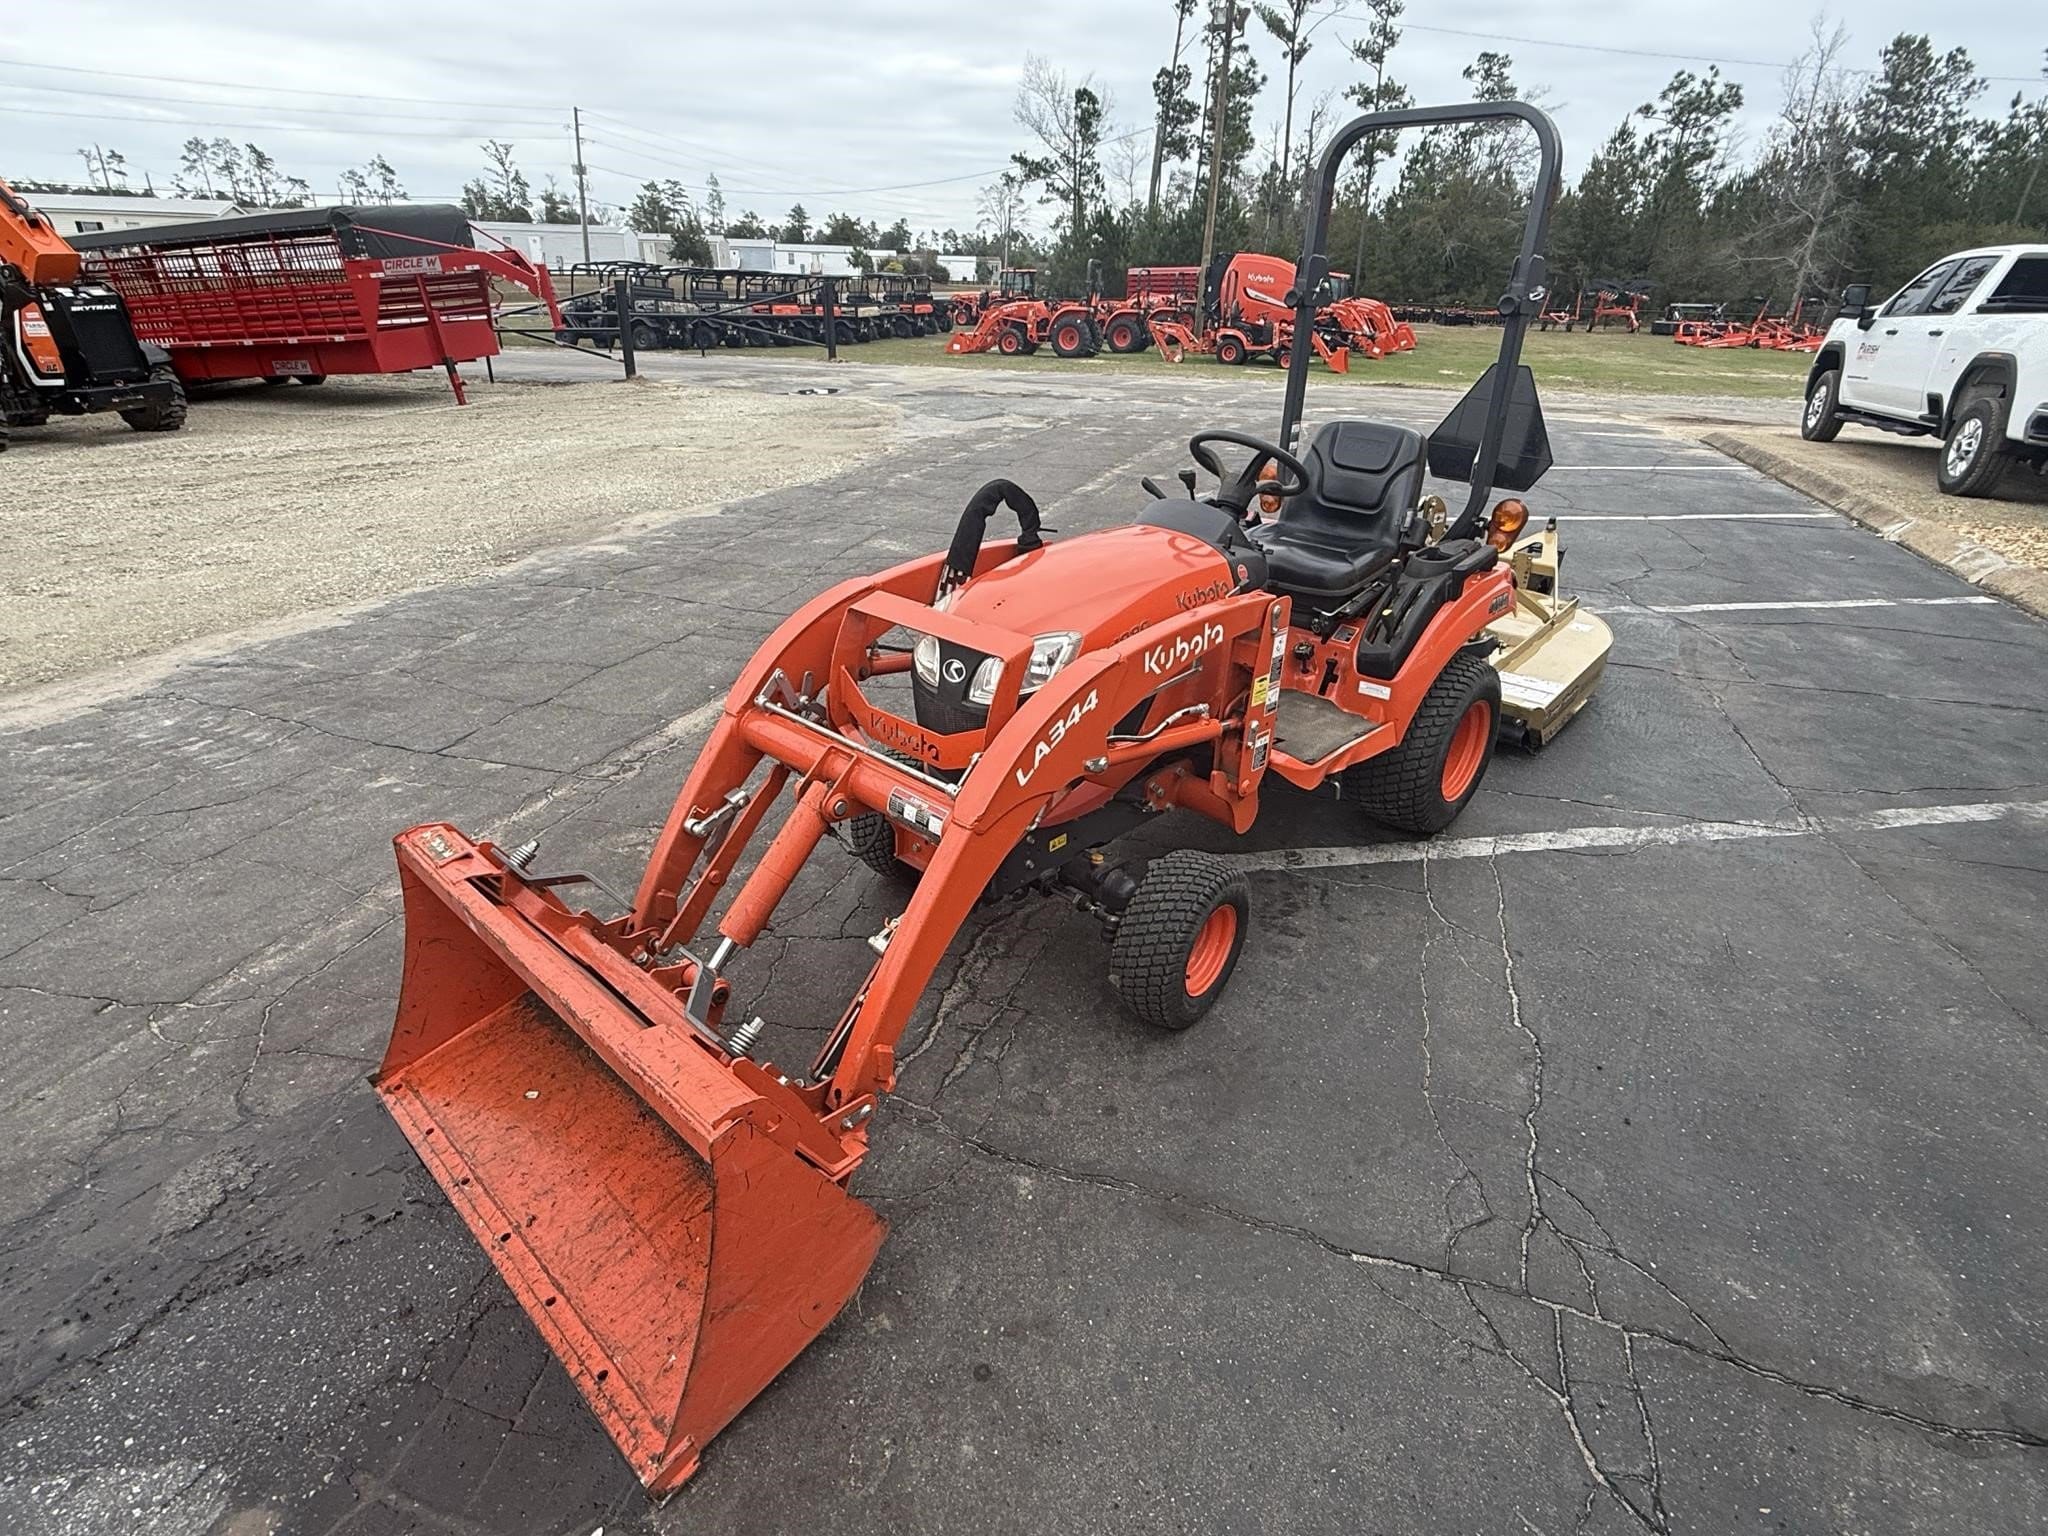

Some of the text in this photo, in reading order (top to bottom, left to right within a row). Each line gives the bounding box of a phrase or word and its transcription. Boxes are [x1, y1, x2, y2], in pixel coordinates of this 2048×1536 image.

[384, 256, 437, 270] CIRCLE W
[1247, 272, 1275, 284] Kubota
[71, 304, 117, 312] SKYTRAK
[1176, 580, 1230, 611] Kubota
[1144, 622, 1224, 675] Kubota
[871, 712, 940, 762] Kubota
[1016, 688, 1099, 787] LA344
